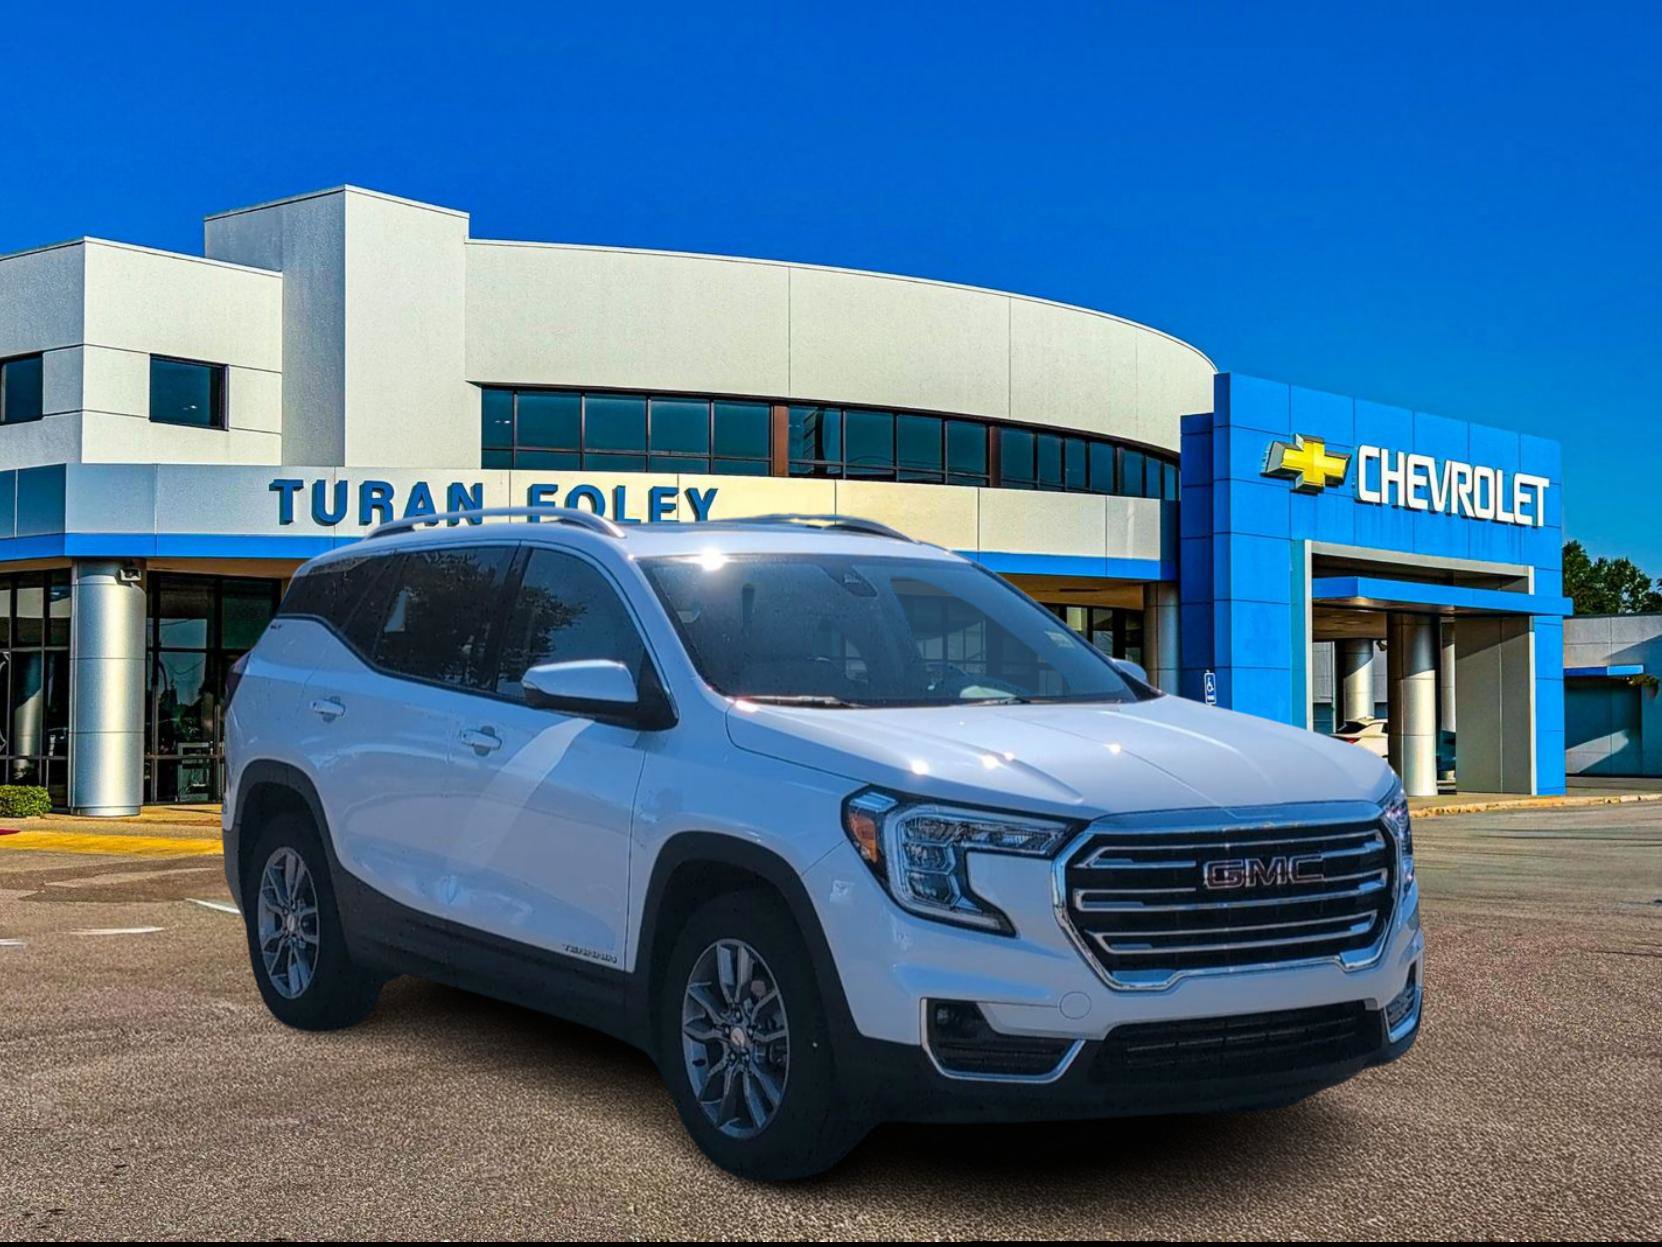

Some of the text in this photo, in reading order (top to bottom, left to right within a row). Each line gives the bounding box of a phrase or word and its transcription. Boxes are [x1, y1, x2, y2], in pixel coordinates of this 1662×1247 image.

[269, 479, 719, 526] TURAN FOLEY
[1356, 444, 1550, 527] CHEVROLET
[1203, 854, 1325, 889] GMC
